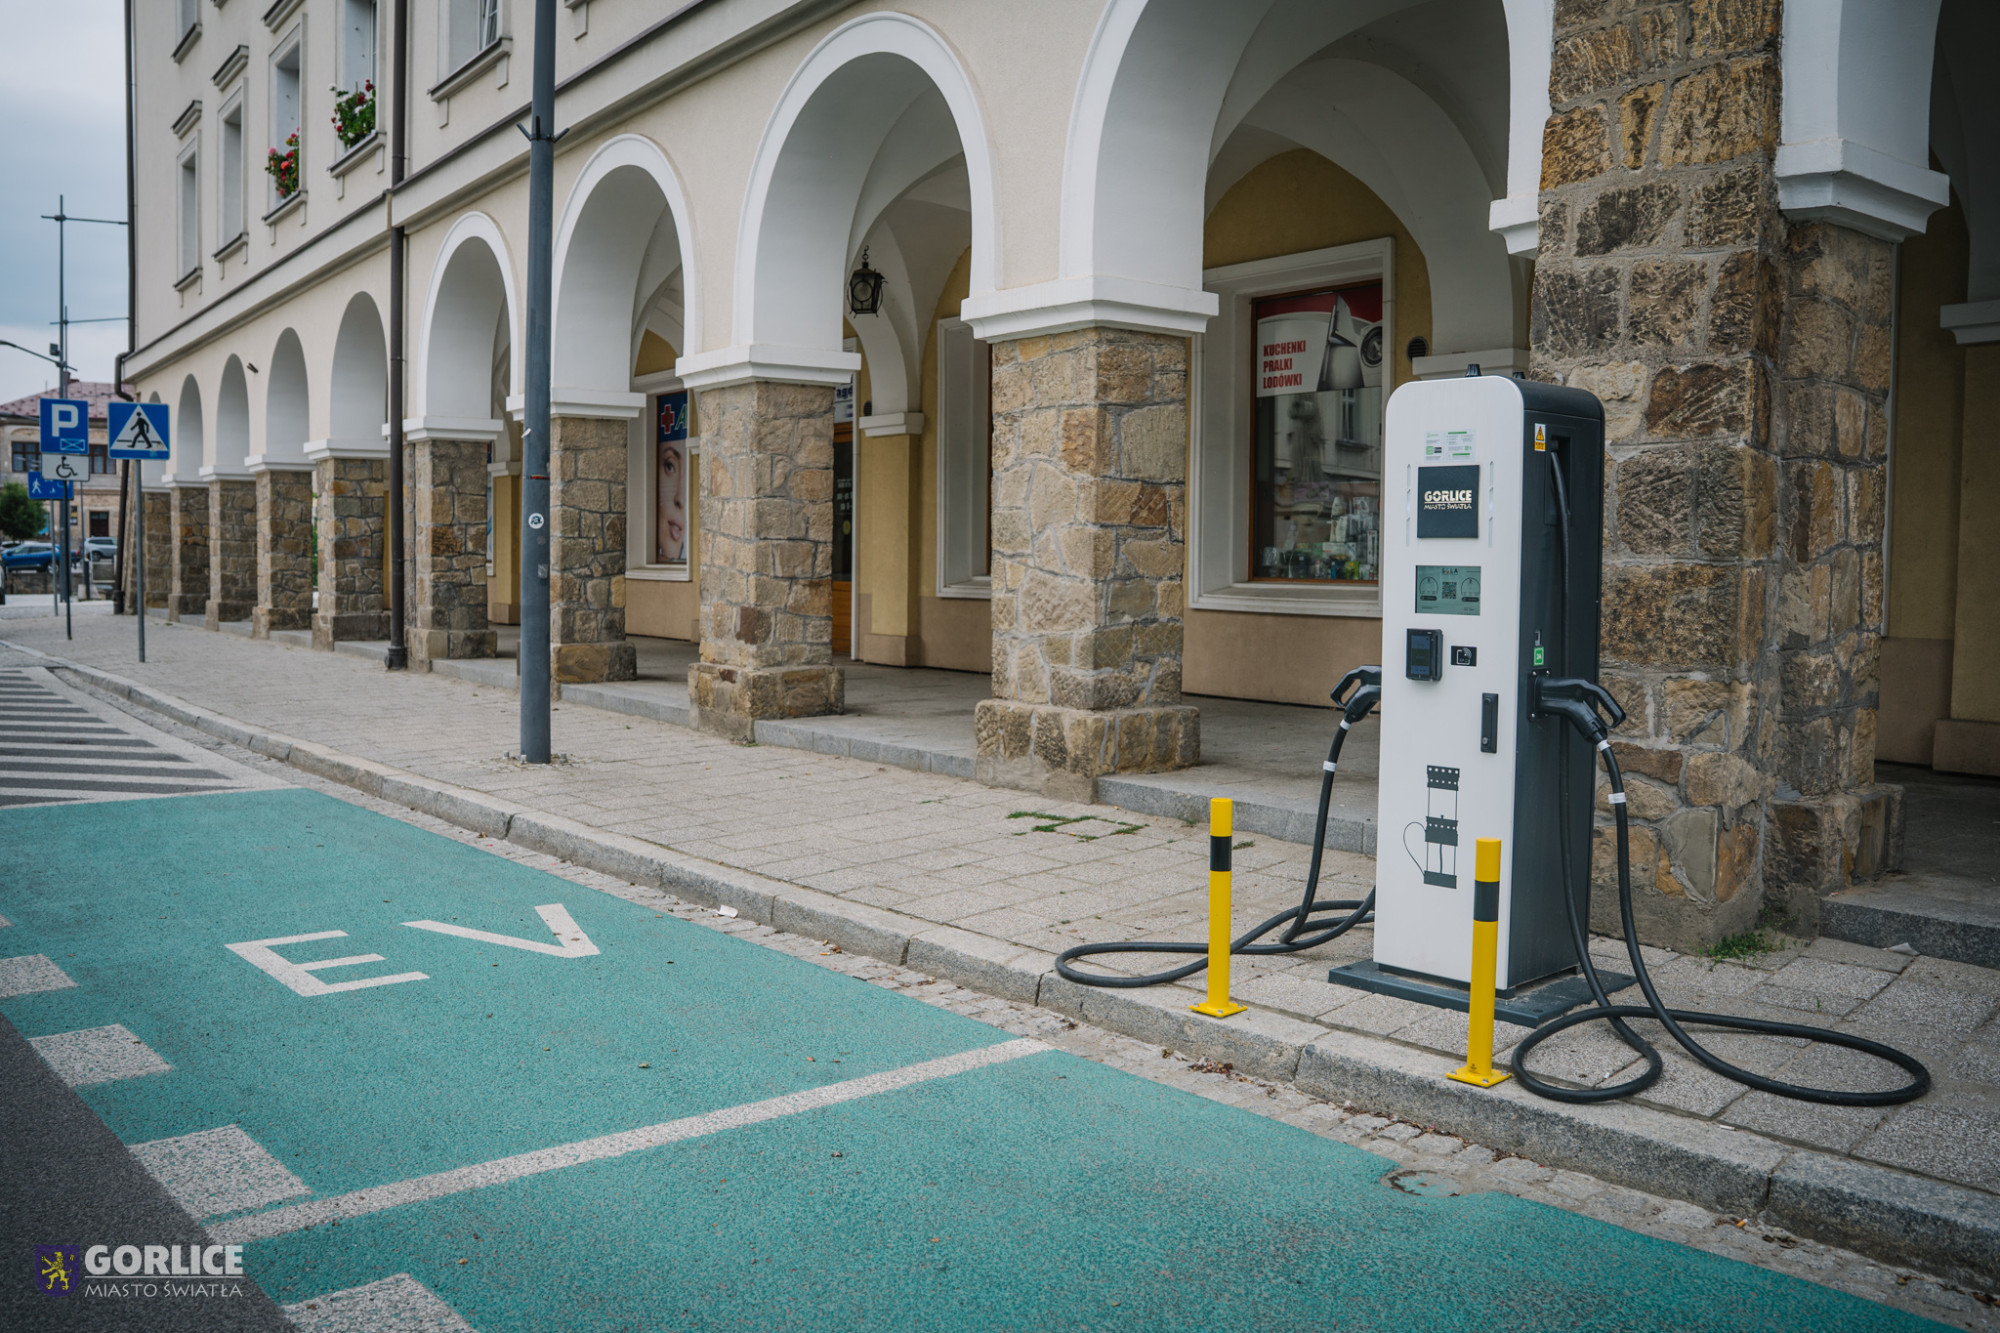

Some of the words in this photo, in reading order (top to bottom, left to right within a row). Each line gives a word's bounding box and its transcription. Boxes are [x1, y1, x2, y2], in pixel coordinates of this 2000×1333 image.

[1263, 340, 1306, 357] KUCHENKI
[1263, 358, 1293, 373] PRALKI
[1263, 373, 1302, 389] LODÓWKI
[52, 403, 79, 437] P
[1424, 489, 1472, 502] GORLICE
